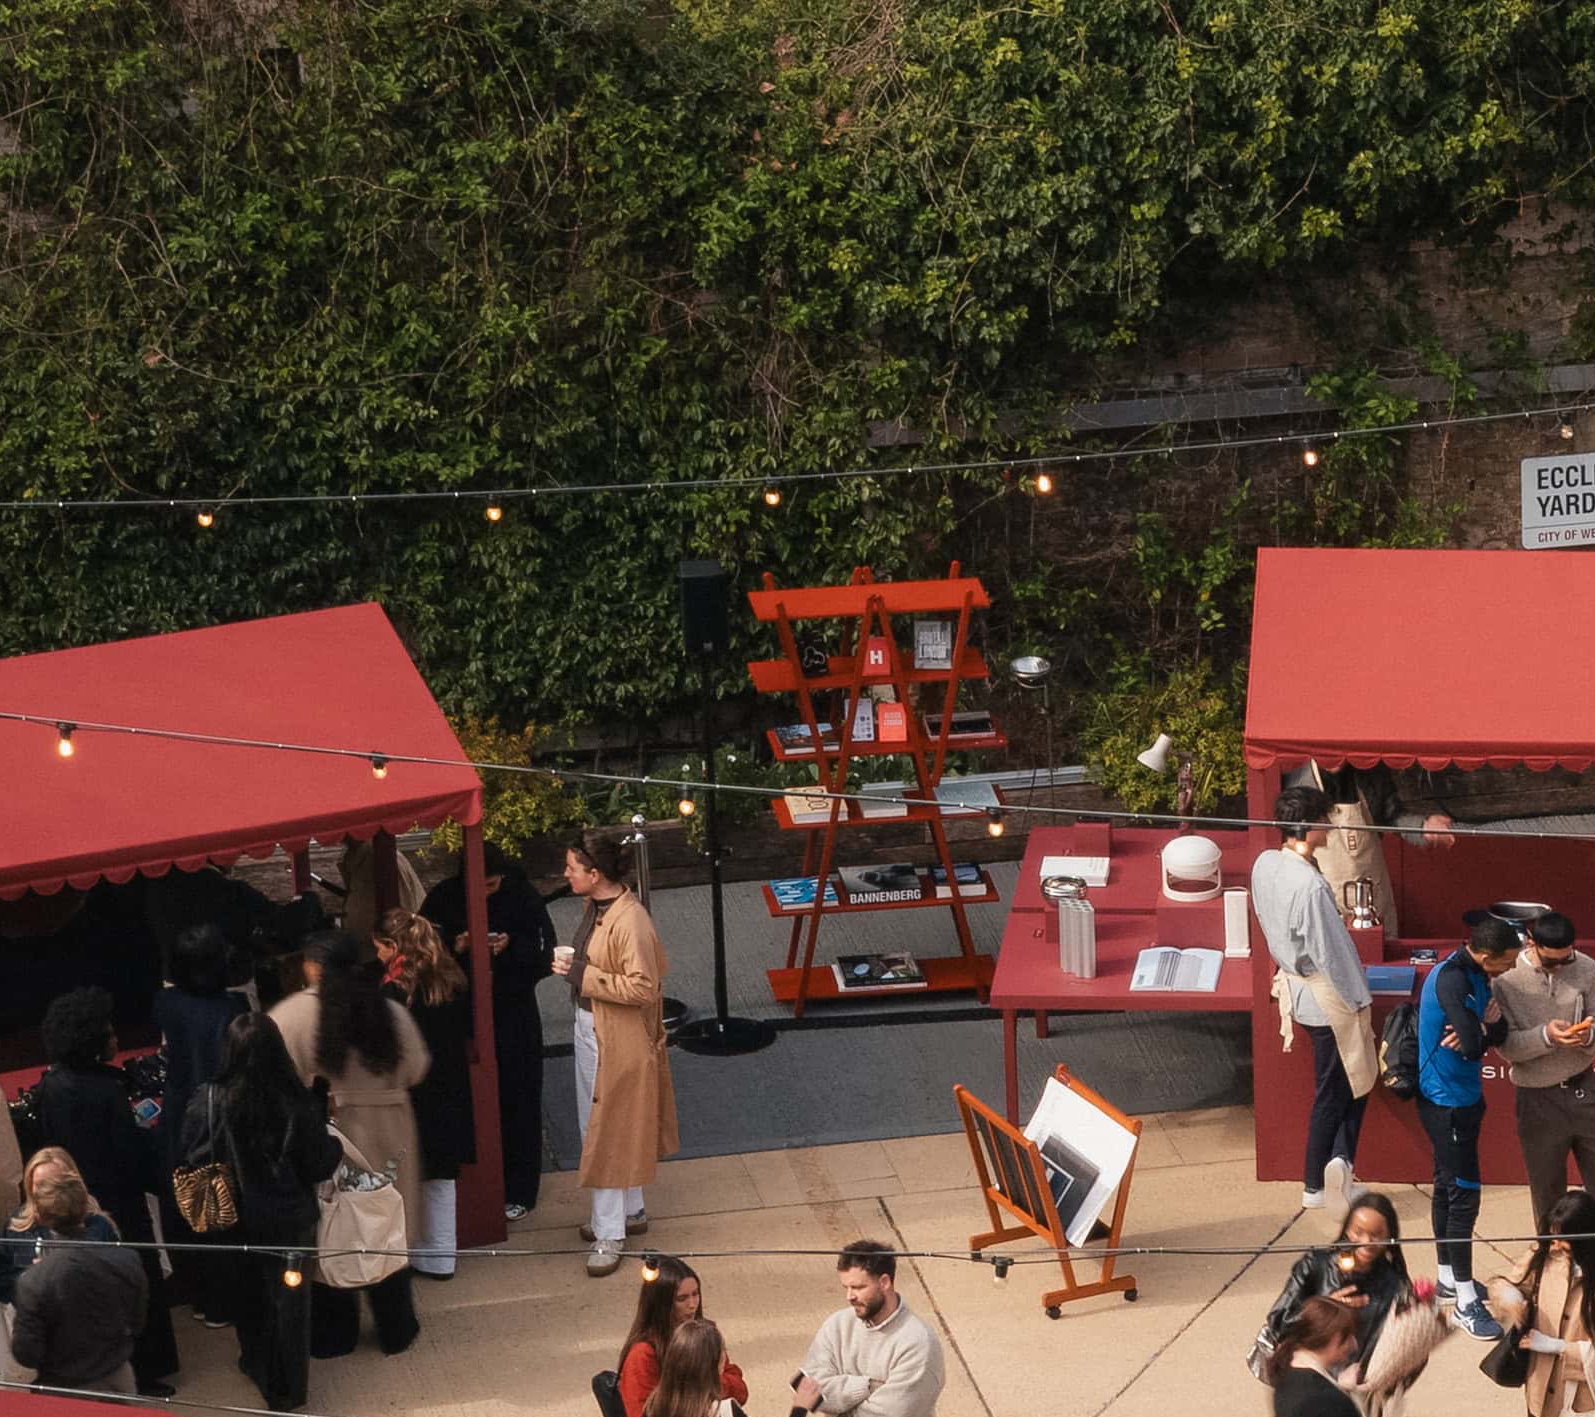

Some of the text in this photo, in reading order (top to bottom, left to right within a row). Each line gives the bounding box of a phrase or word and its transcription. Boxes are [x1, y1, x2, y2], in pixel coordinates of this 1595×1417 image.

[1536, 492, 1595, 517] YARD
[1538, 531, 1561, 543] CITY
[1564, 530, 1578, 540] OF
[869, 650, 883, 664] H
[849, 888, 922, 905] BANNENBERG
